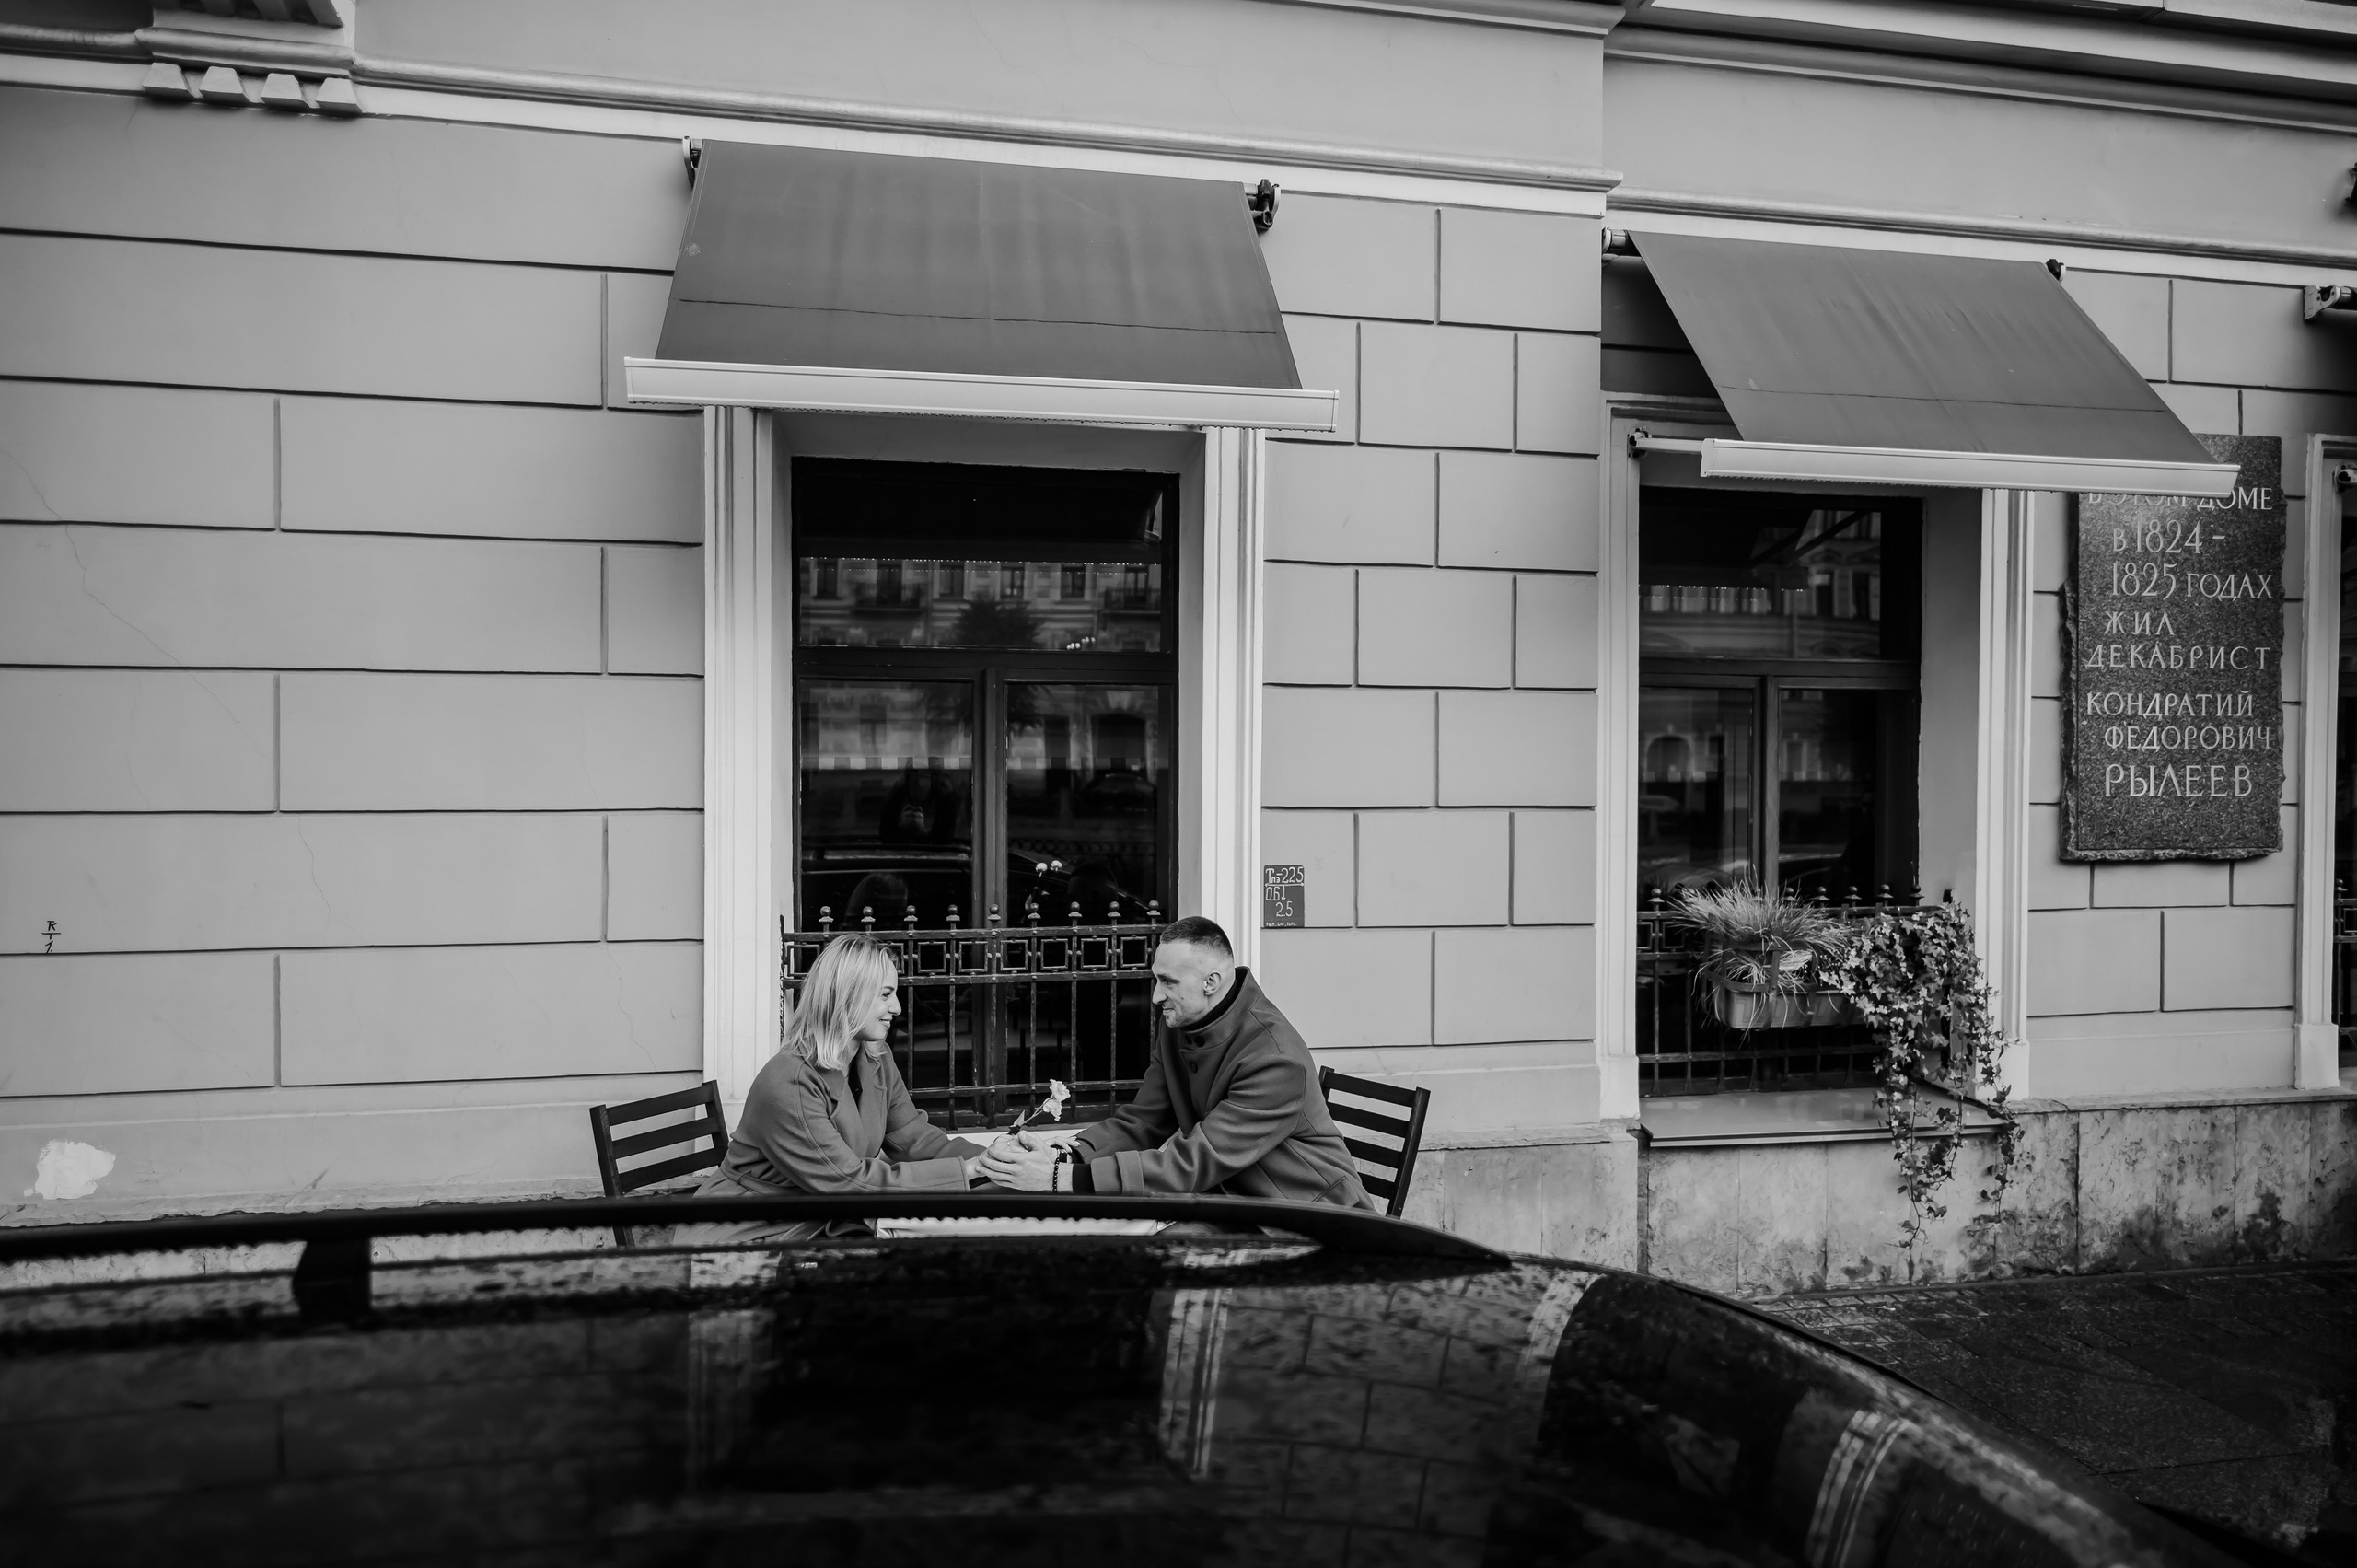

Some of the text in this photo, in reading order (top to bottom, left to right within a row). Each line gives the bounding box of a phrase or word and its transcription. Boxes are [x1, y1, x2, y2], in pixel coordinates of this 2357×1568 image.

[2112, 561, 2178, 599] 1825
[2104, 610, 2175, 636] ЖИЛ
[2084, 644, 2270, 670] ДЕКАБРИСТ
[2086, 690, 2254, 719] КОНДРАТИЙ
[2104, 725, 2271, 752] ФЕДОРОВИЧ
[2105, 763, 2253, 797] РЫЛЕЕВ
[1275, 900, 1294, 917] 2.5
